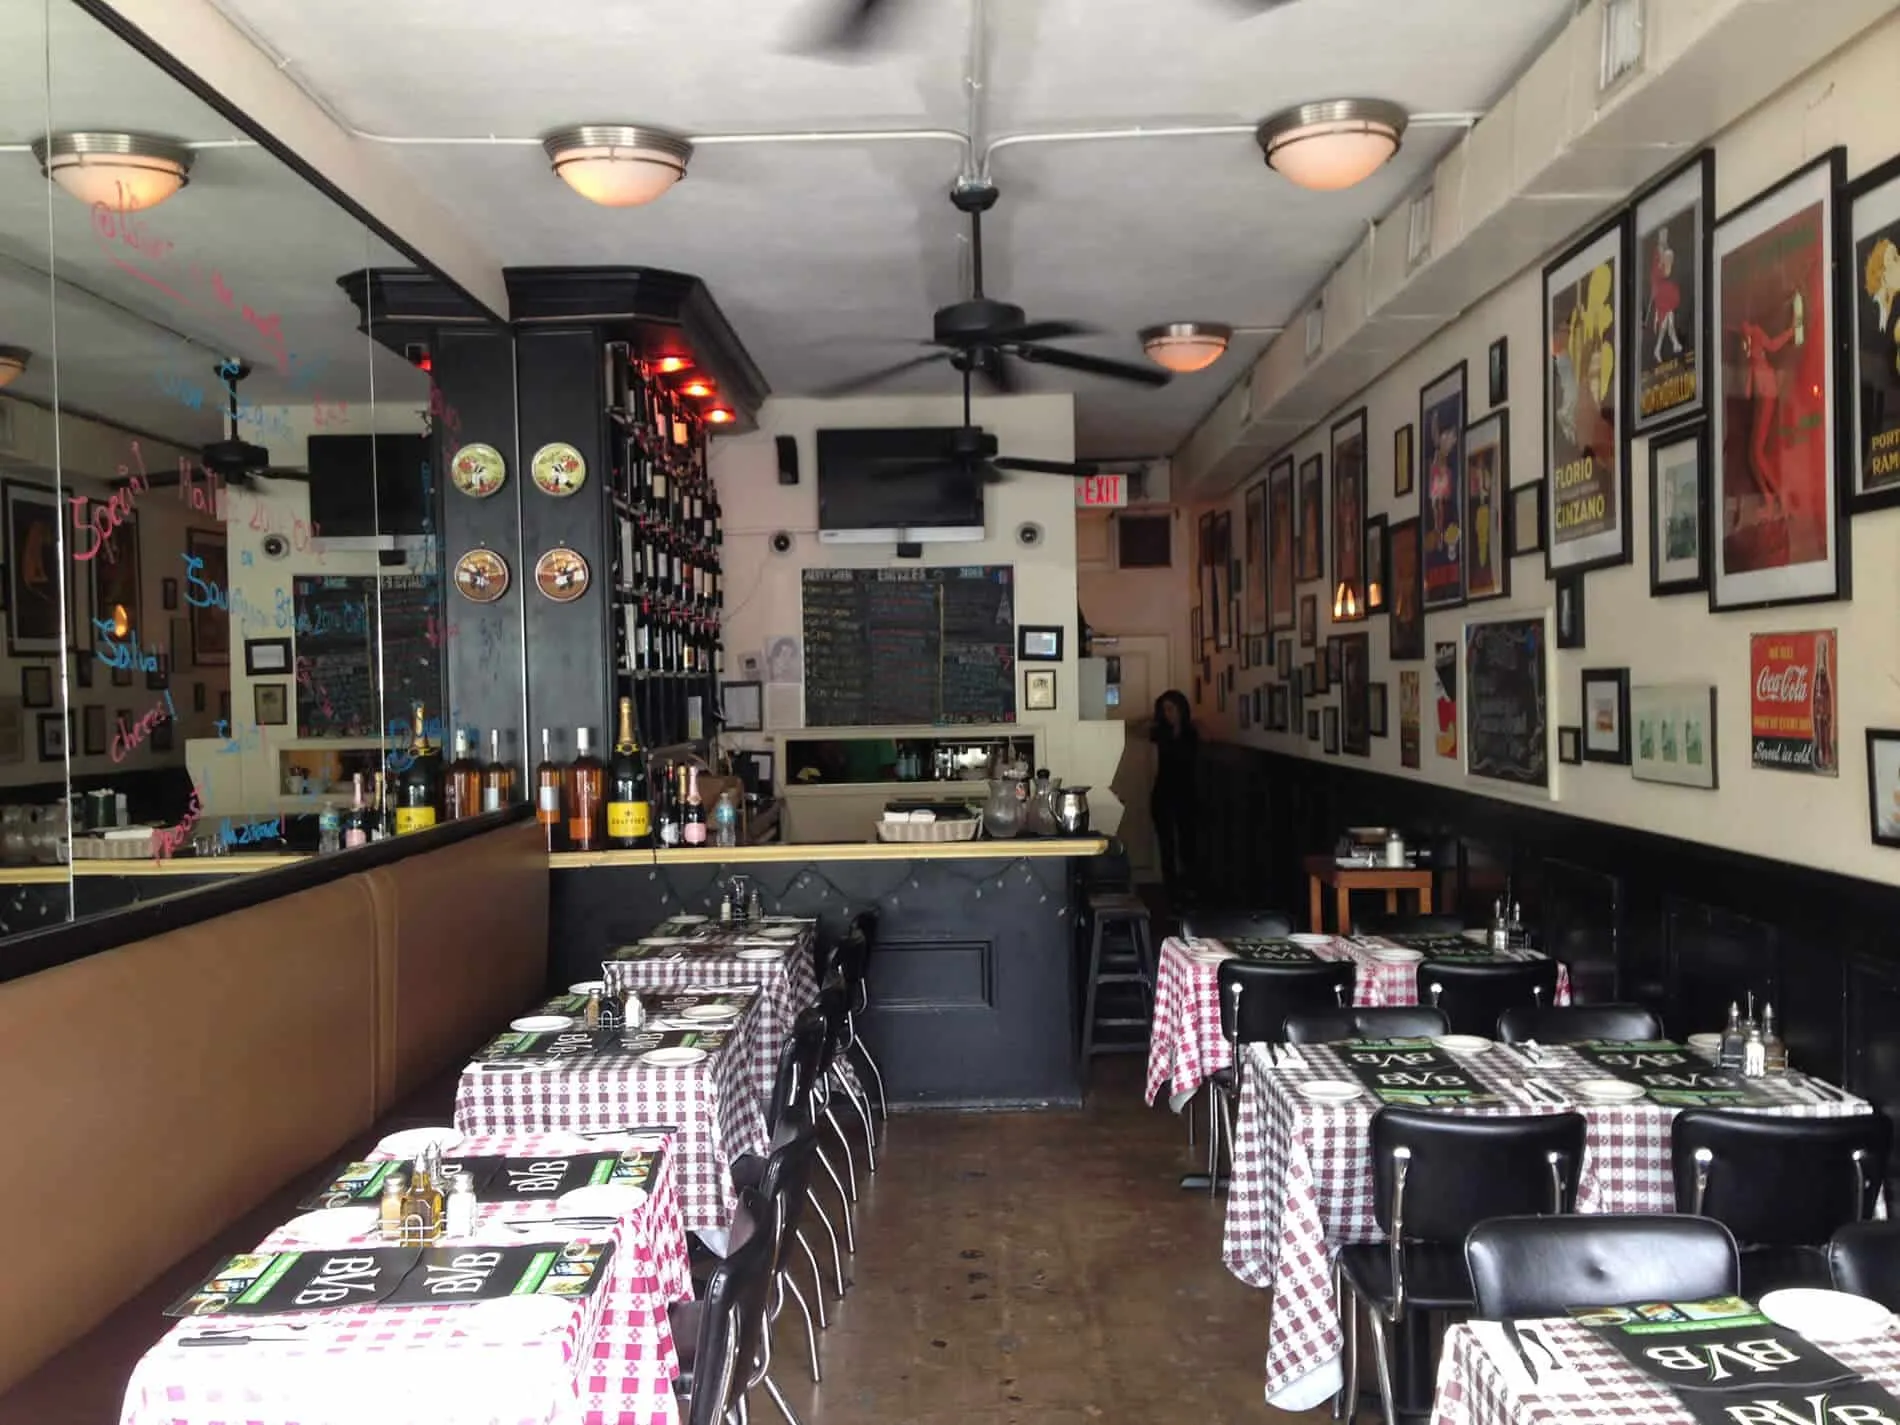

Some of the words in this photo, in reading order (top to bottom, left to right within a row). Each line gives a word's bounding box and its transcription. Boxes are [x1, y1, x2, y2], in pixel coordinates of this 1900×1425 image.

[1555, 456, 1592, 488] FLORIO
[1084, 475, 1120, 505] EXIT
[1556, 495, 1605, 529] CINZANO
[1756, 664, 1808, 703] Coca-Cola
[1644, 1339, 1801, 1382] BVB
